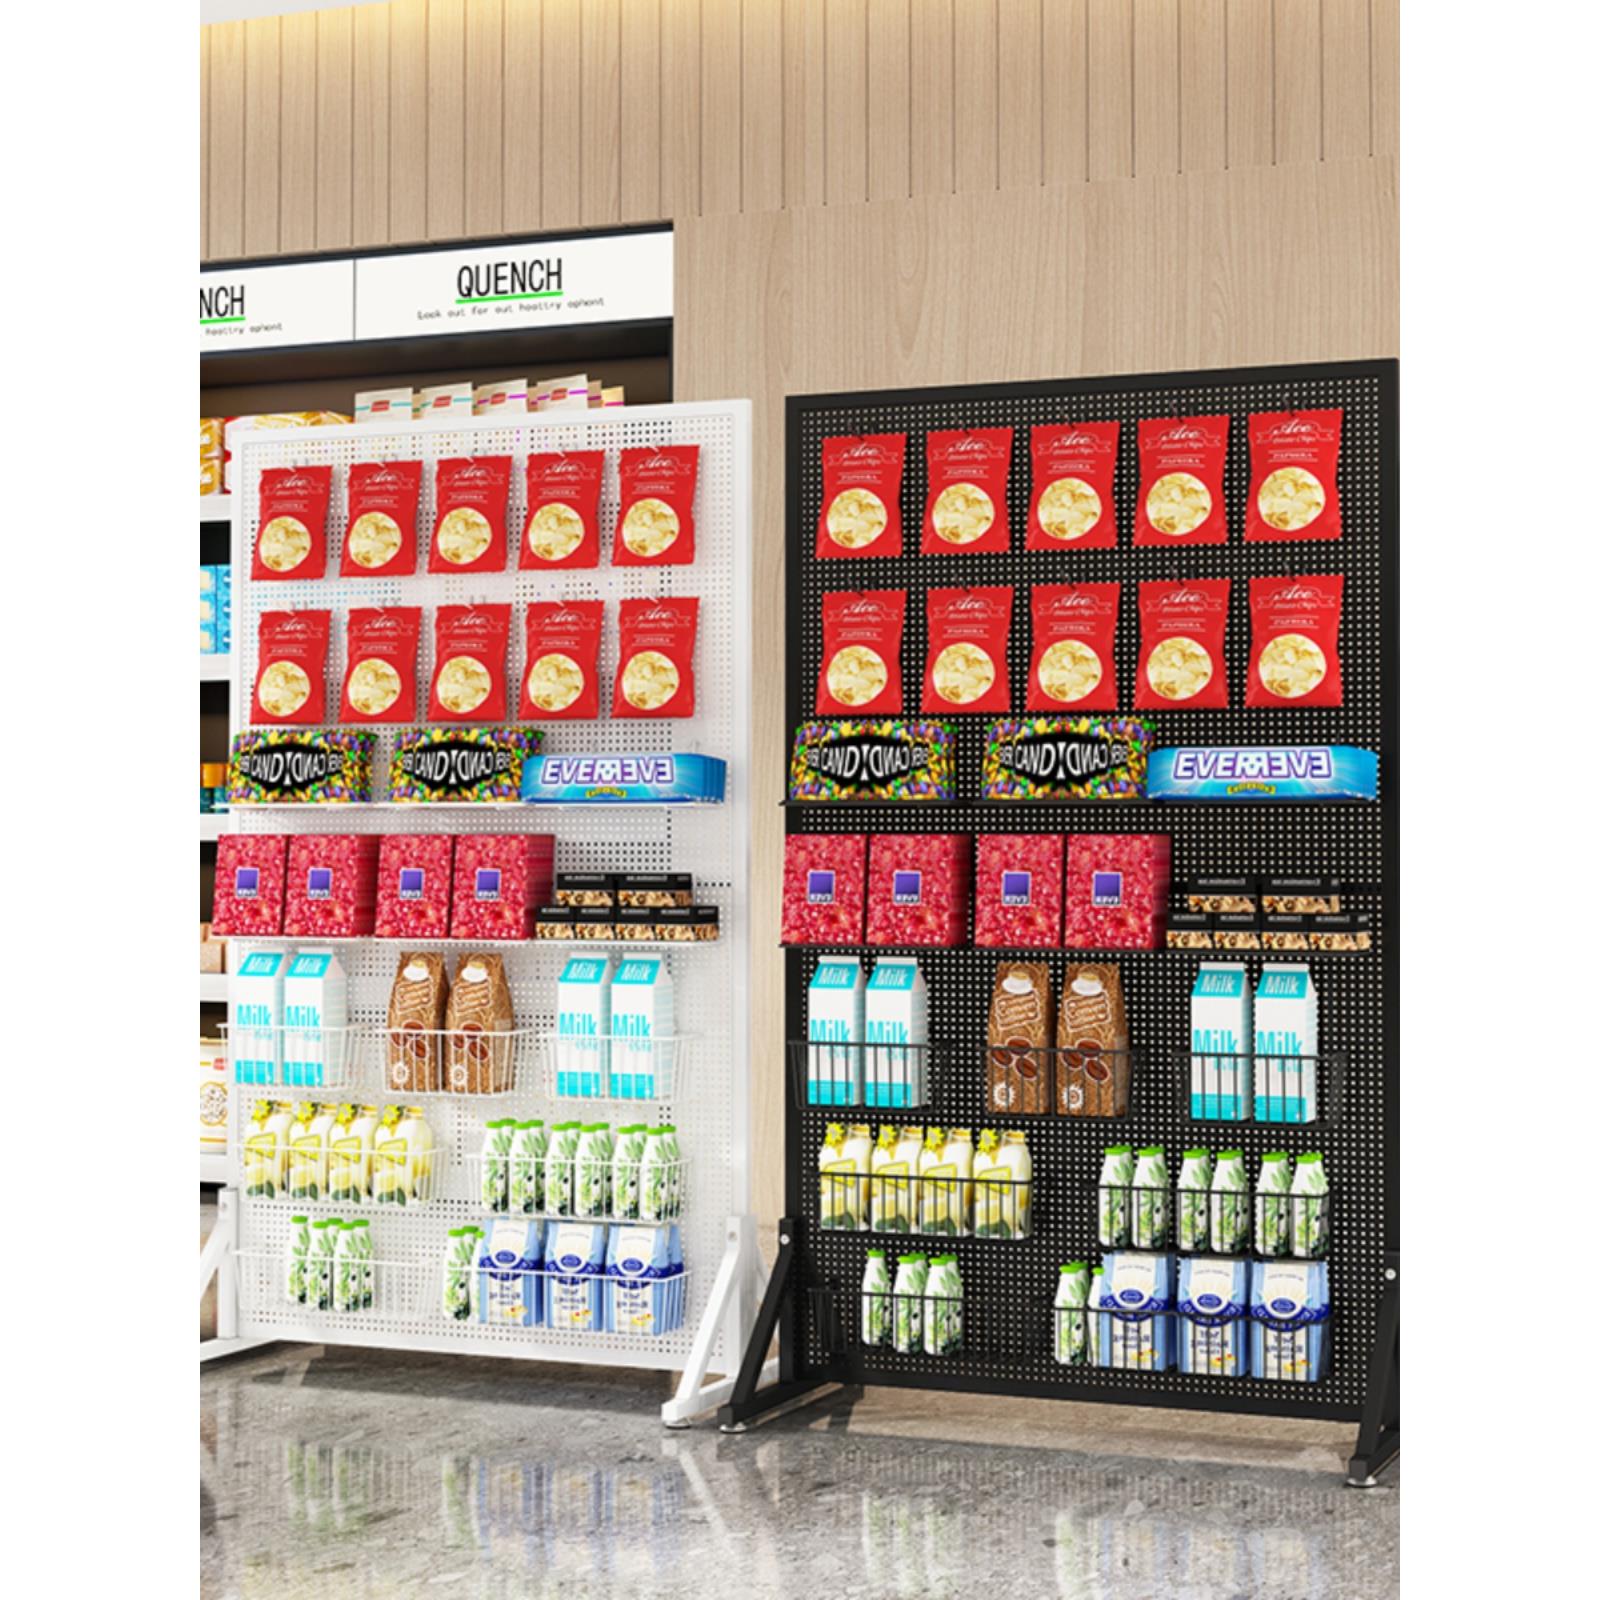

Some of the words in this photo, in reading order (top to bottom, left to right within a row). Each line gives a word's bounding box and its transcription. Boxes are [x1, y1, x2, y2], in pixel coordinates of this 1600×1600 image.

[457, 258, 562, 298] QUENCH
[200, 285, 244, 319] NCH
[246, 957, 272, 973] Milk
[294, 957, 321, 974] Milk
[568, 962, 597, 979] Milk
[622, 964, 650, 980] Milk
[818, 967, 849, 984] Milk
[875, 968, 907, 985] Milk
[1202, 975, 1235, 992] Milk
[1265, 976, 1299, 994] Milk
[237, 1004, 272, 1029] Milk
[286, 1006, 321, 1031] Milk
[559, 1013, 597, 1039] Milk
[613, 1014, 651, 1041] Milk
[810, 1020, 850, 1042] Milk
[868, 1021, 909, 1044] Milk
[1194, 1029, 1238, 1054] Milk
[1257, 1031, 1303, 1056] Milk
